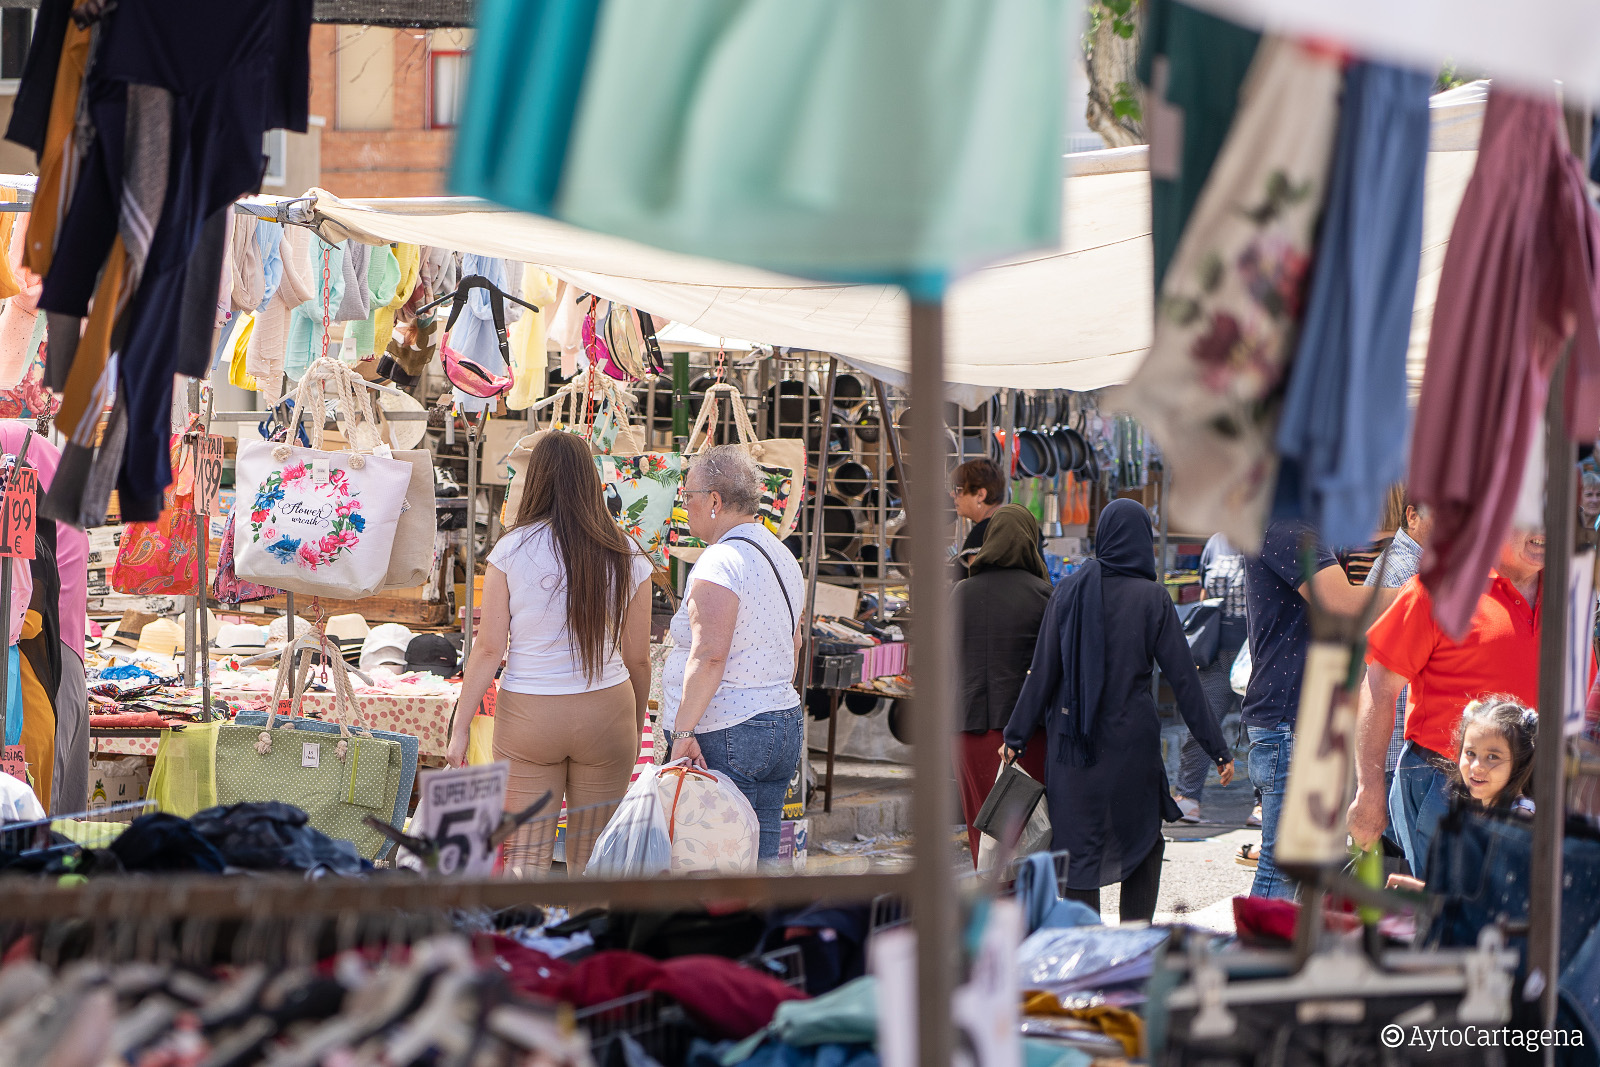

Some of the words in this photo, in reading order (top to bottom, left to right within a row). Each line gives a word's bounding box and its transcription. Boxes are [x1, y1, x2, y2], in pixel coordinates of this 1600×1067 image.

[8, 470, 35, 494] RTA
[278, 499, 333, 519] Flower
[291, 515, 329, 529] wreath
[14, 535, 23, 554] €
[432, 782, 468, 807] SUPER
[469, 775, 502, 801] OFERTA
